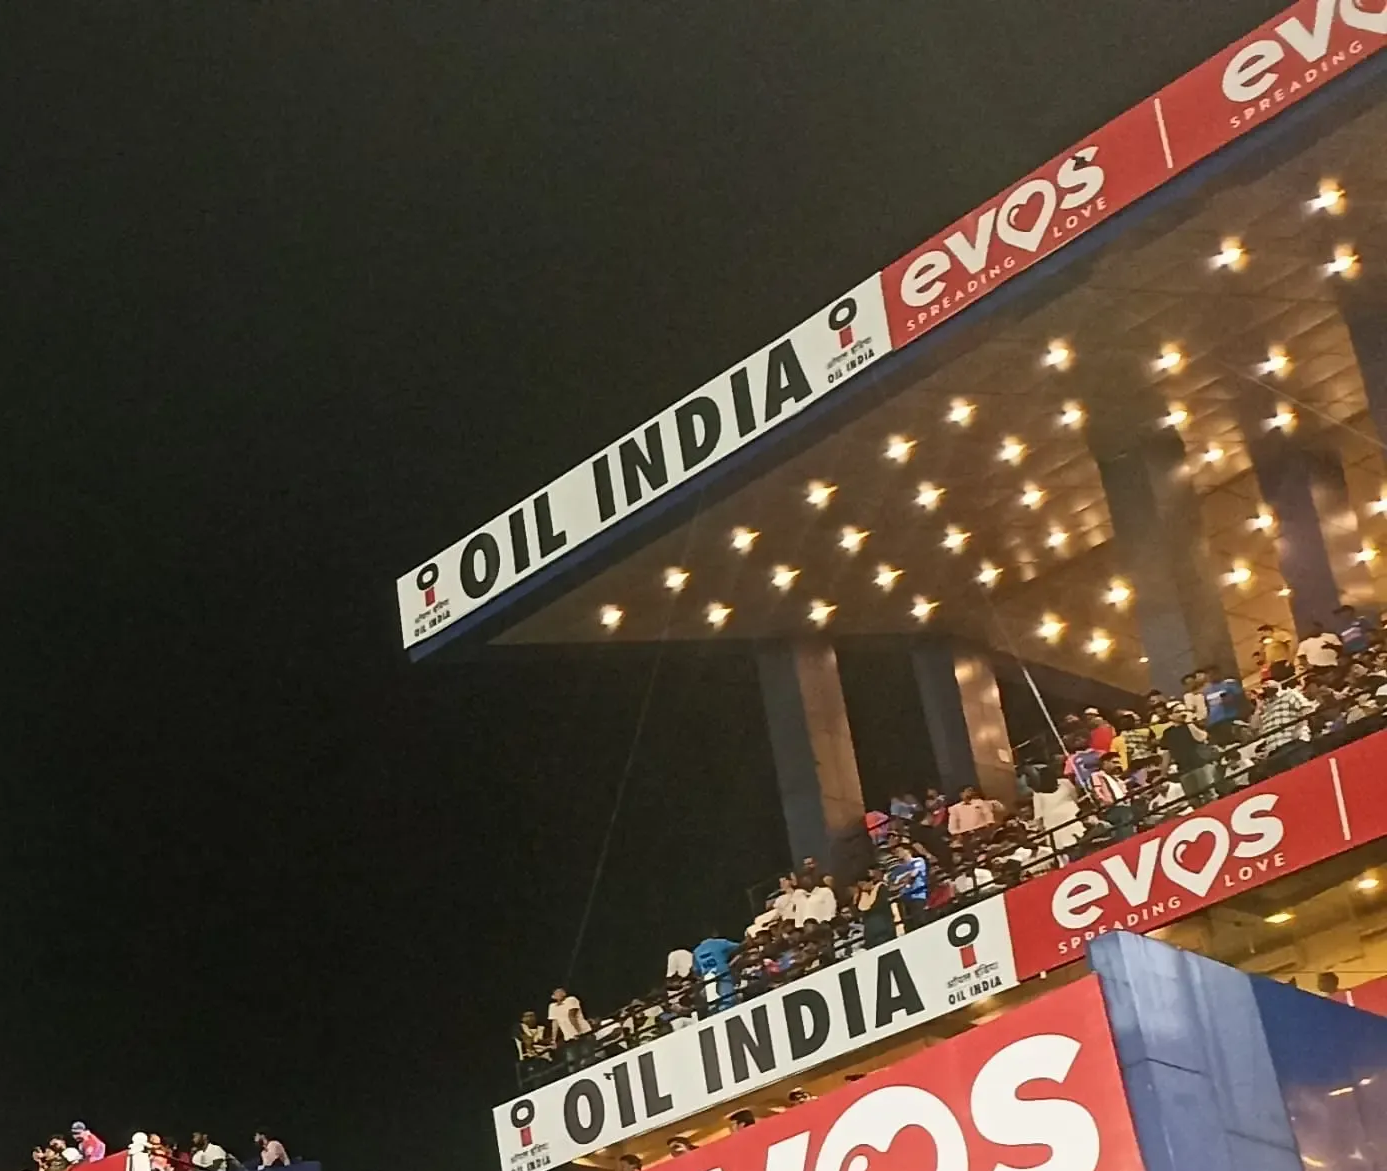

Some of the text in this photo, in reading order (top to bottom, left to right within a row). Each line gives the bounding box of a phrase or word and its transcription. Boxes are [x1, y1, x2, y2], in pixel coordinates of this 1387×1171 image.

[1230, 40, 1363, 128] SPREADING
[901, 146, 1104, 307] evos
[907, 197, 1107, 331] SPREADING LOVE
[460, 339, 813, 599] OIL INDIA
[1051, 794, 1284, 929] evos
[1224, 852, 1285, 887] LOVE
[564, 949, 925, 1145] OIL INDIA
[949, 976, 1002, 1005] OIL INDIA
